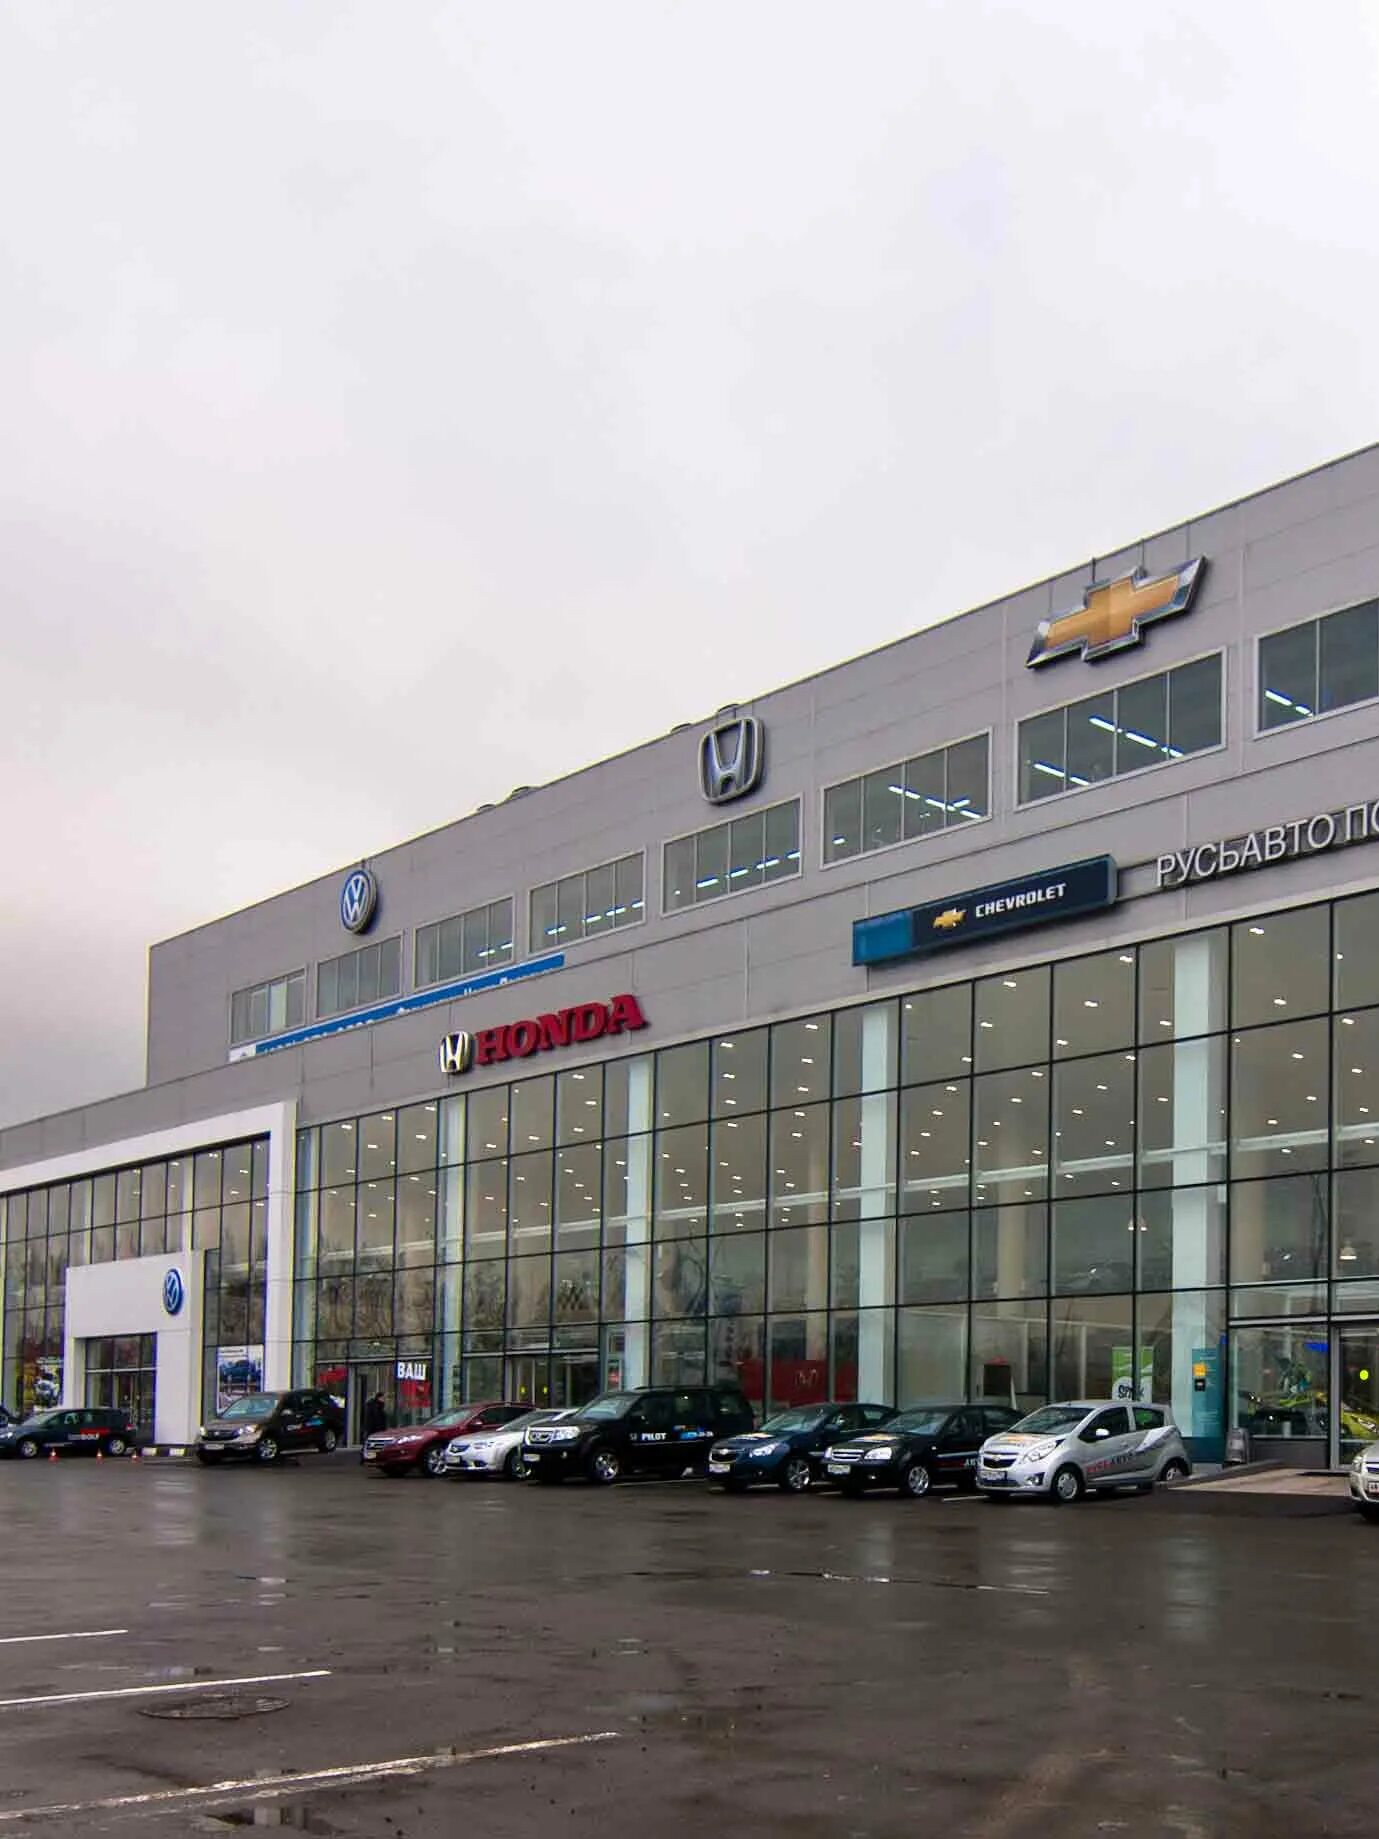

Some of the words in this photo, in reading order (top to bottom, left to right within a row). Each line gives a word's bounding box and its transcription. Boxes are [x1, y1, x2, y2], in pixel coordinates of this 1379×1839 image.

[1155, 814, 1336, 887] РУСЬАВТО
[975, 883, 1067, 918] CHEVROLET
[475, 993, 647, 1066] HONDA
[397, 1361, 427, 1380] ВАШ
[641, 1432, 667, 1441] PILOT
